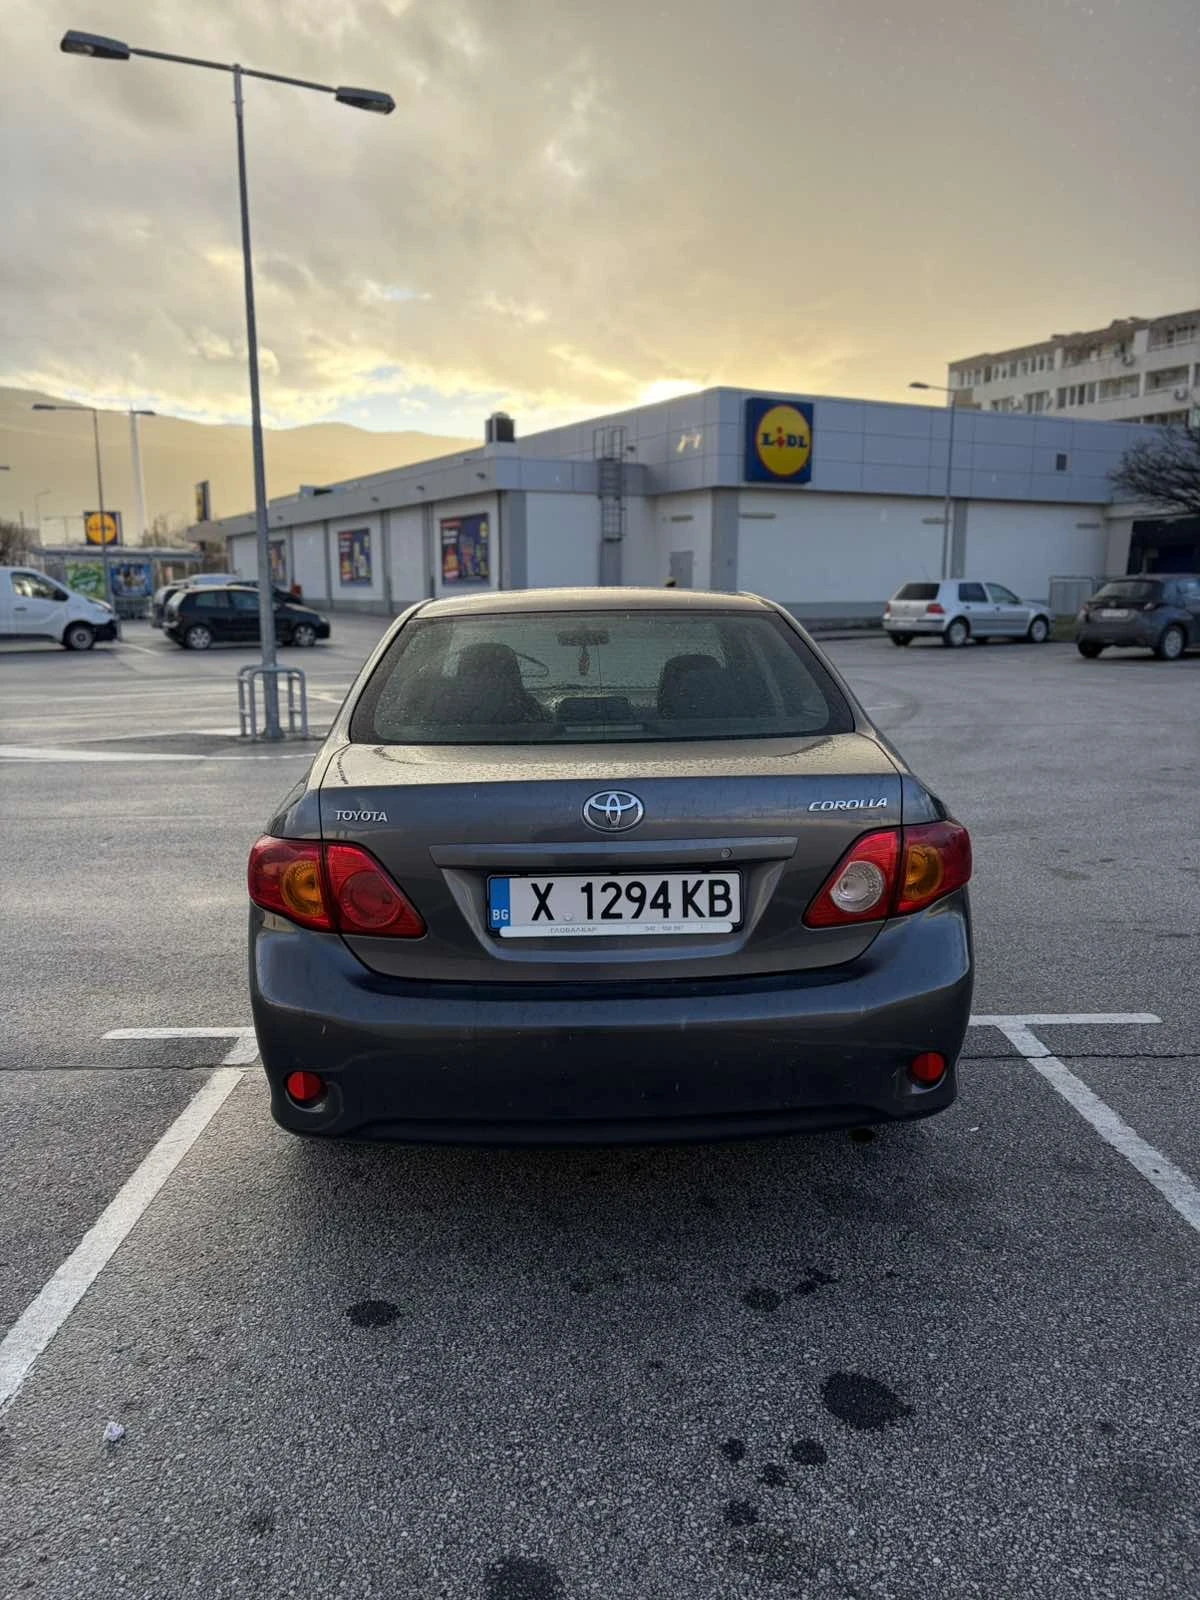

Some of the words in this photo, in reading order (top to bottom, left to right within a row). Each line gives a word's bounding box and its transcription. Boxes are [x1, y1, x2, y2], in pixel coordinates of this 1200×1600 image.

[808, 797, 888, 812] COROLLA
[334, 810, 388, 822] TOYOTA
[530, 882, 555, 921] X
[492, 909, 509, 921] BG
